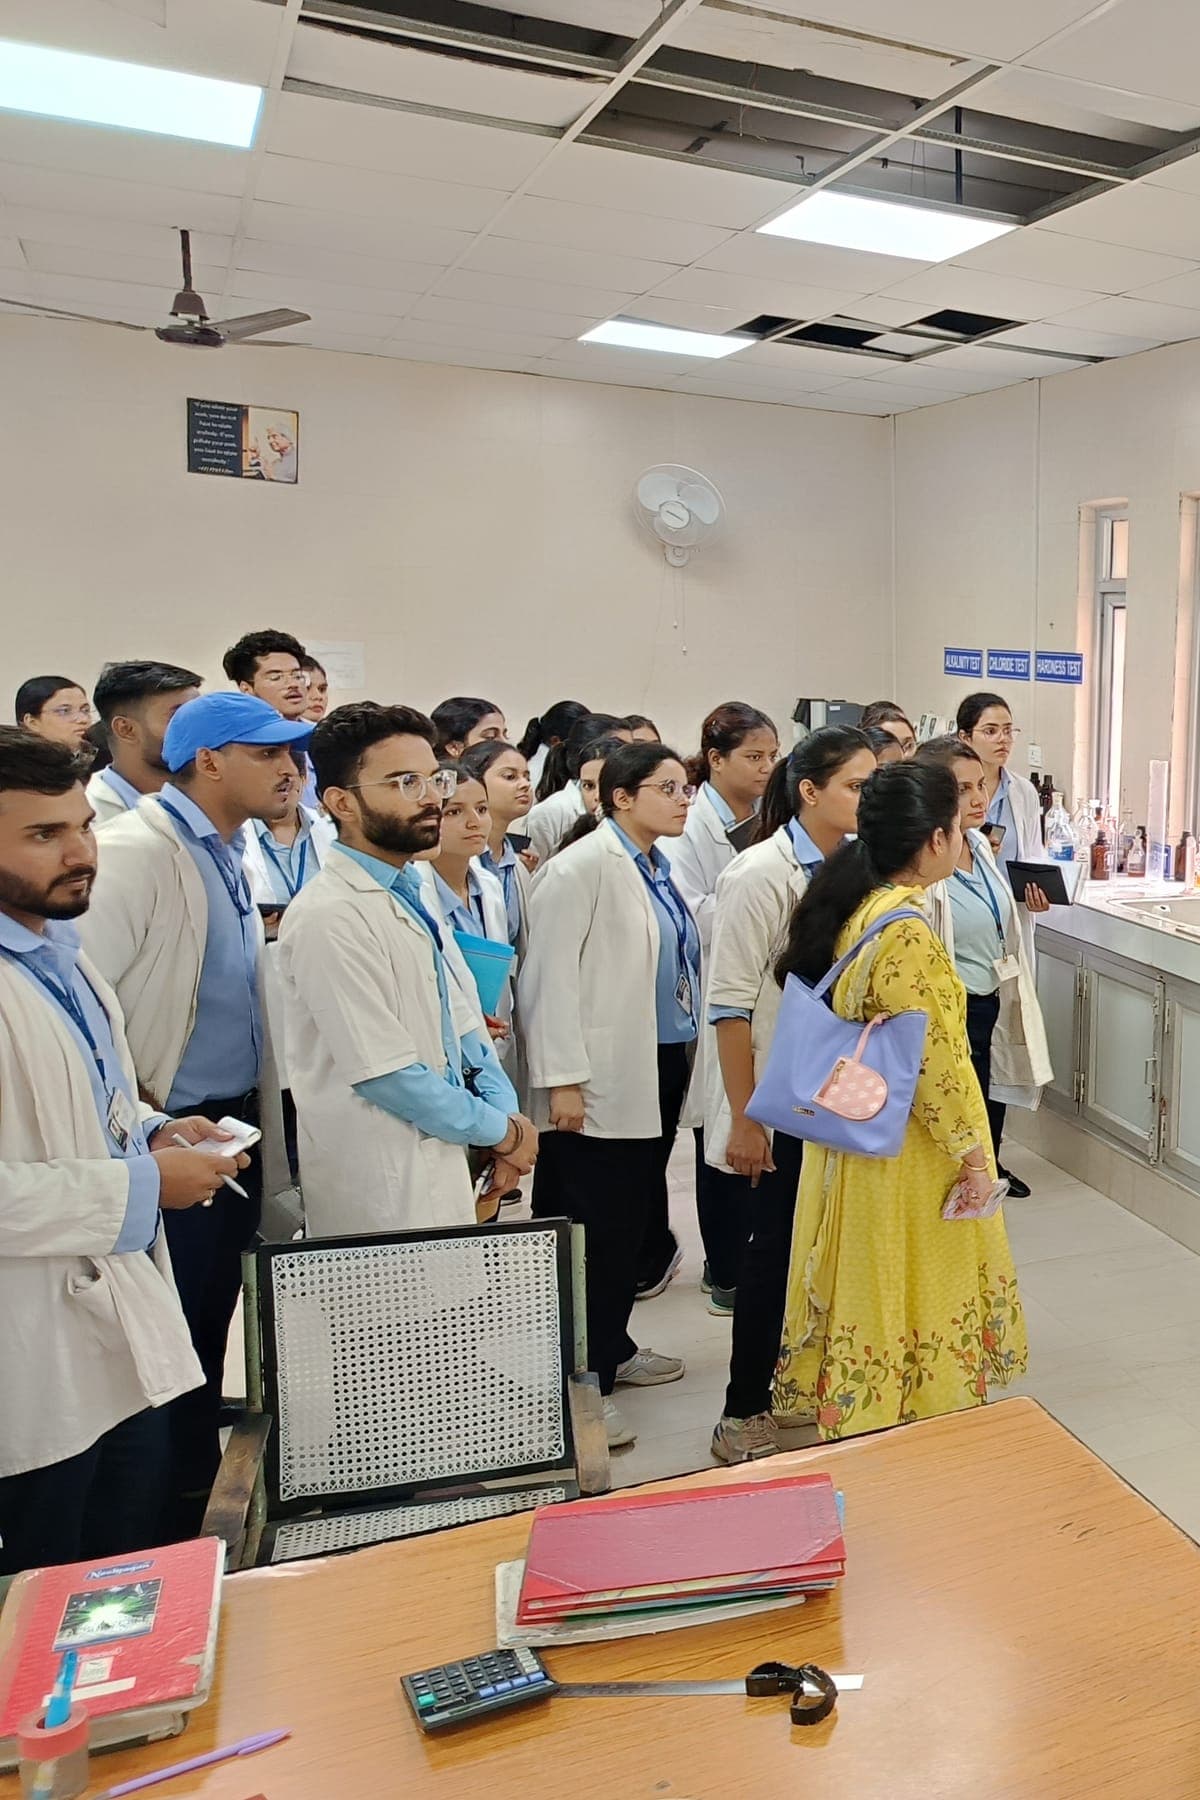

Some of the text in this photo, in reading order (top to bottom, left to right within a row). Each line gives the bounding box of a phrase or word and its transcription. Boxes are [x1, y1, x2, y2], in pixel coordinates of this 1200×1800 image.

[969, 656, 981, 672] TEST
[988, 656, 1028, 673] CHLORIDE TEST
[1036, 659, 1081, 676] HARDNESS TEST
